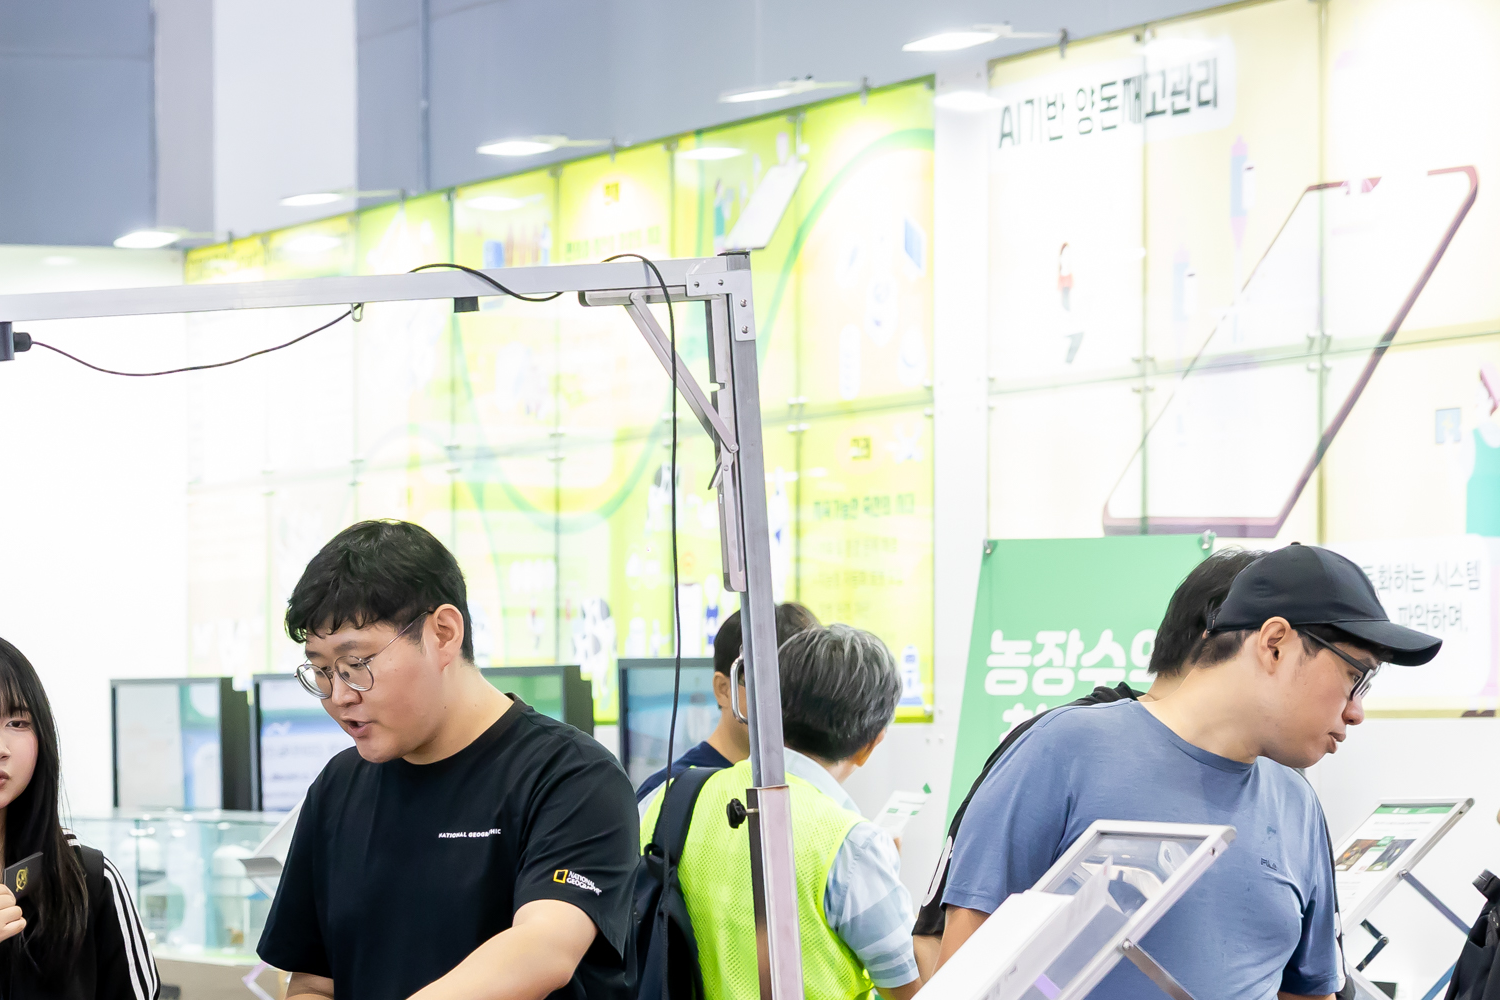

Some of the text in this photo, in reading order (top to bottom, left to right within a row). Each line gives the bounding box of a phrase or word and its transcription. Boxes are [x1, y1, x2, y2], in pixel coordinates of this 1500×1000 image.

[997, 57, 1219, 149] AI기반 양돈재고관리
[1431, 559, 1481, 592] 시스템
[568, 870, 596, 888] NATIONAL
